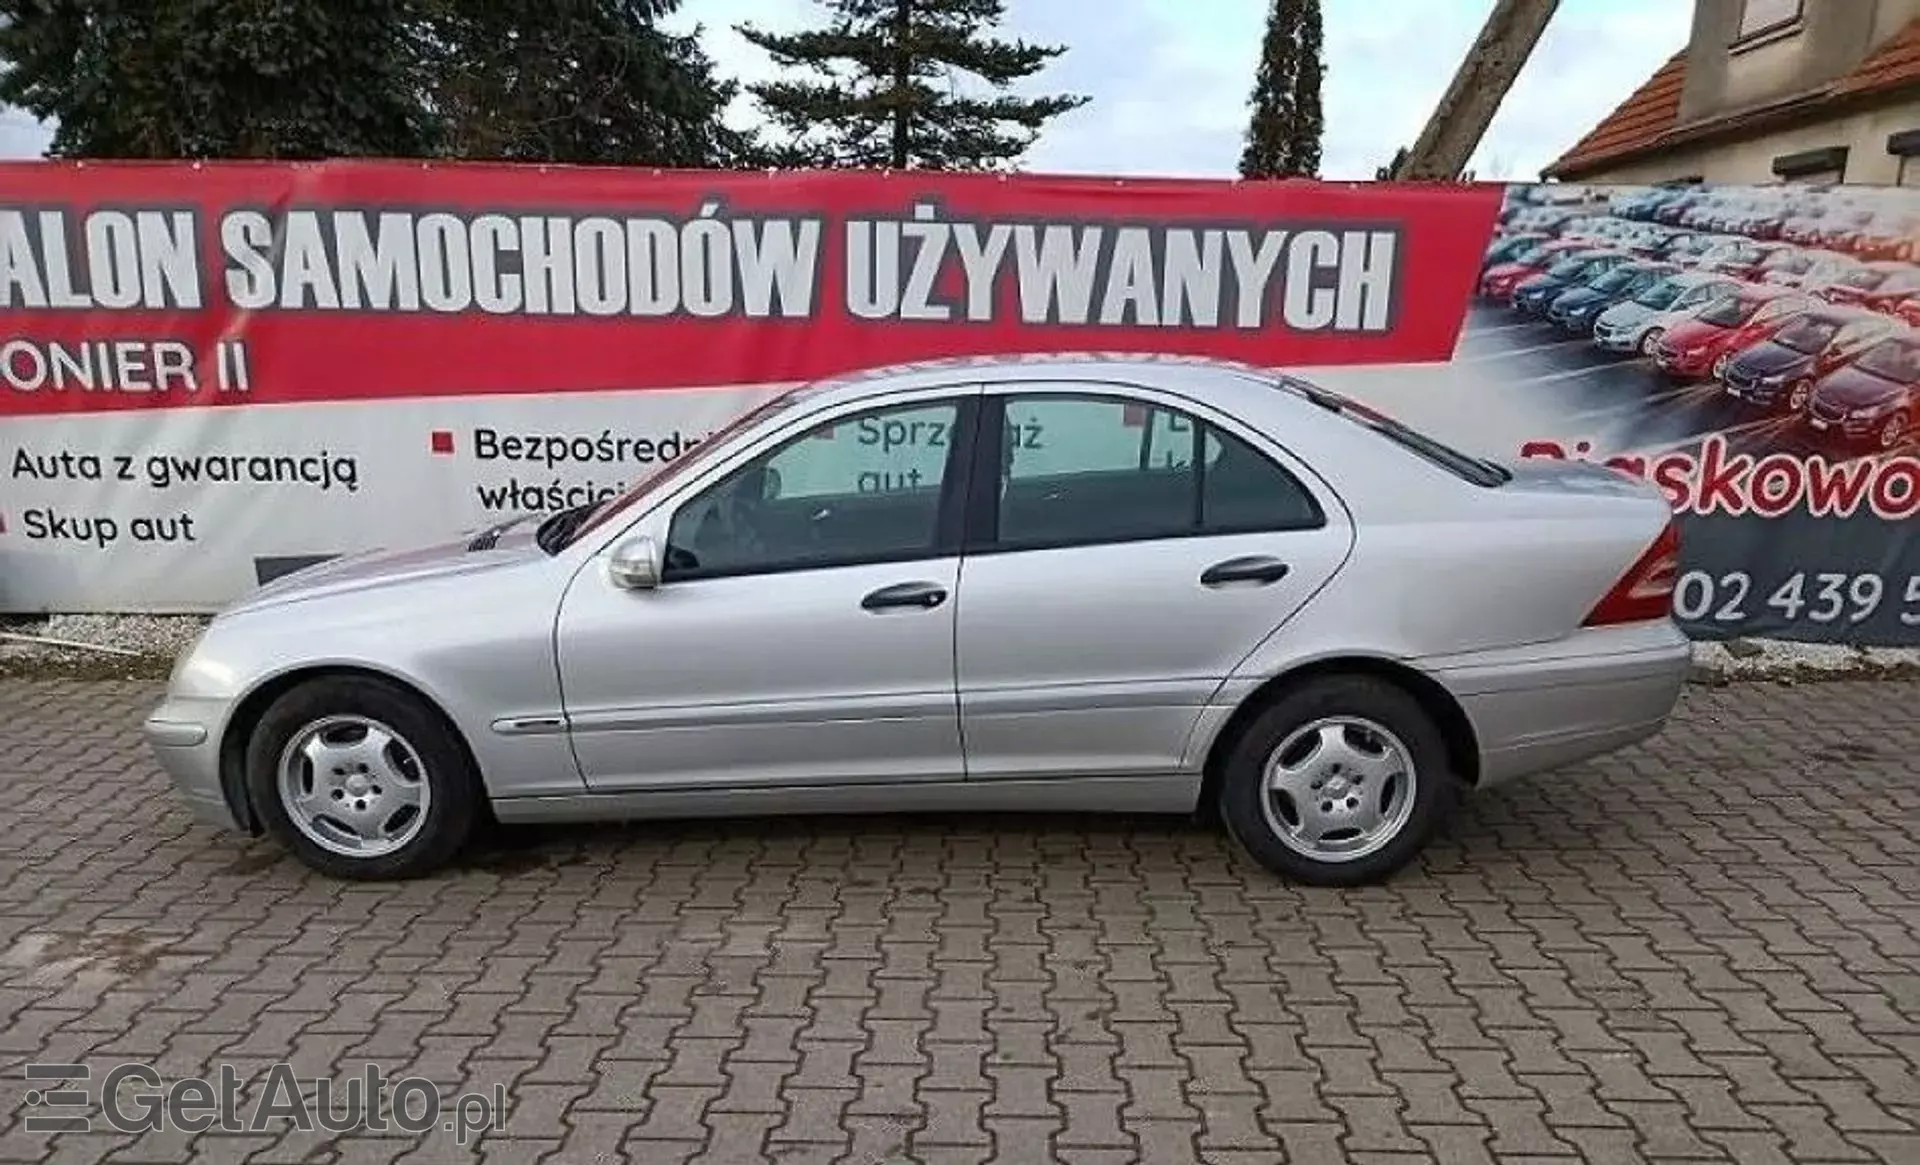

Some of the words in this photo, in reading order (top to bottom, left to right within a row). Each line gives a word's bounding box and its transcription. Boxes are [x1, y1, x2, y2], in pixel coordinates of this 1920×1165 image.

[221, 203, 821, 317] SAMOCHODÓW
[846, 203, 1397, 332] UŻYWANYCH
[0, 340, 196, 391] ONIER
[215, 342, 249, 391] II
[12, 449, 100, 479] Auta
[113, 456, 136, 480] z
[146, 450, 358, 491] gwarancją
[24, 508, 118, 549] Skup
[130, 514, 197, 541] aut
[1673, 570, 1751, 619] 02
[1768, 572, 1883, 623] 439
